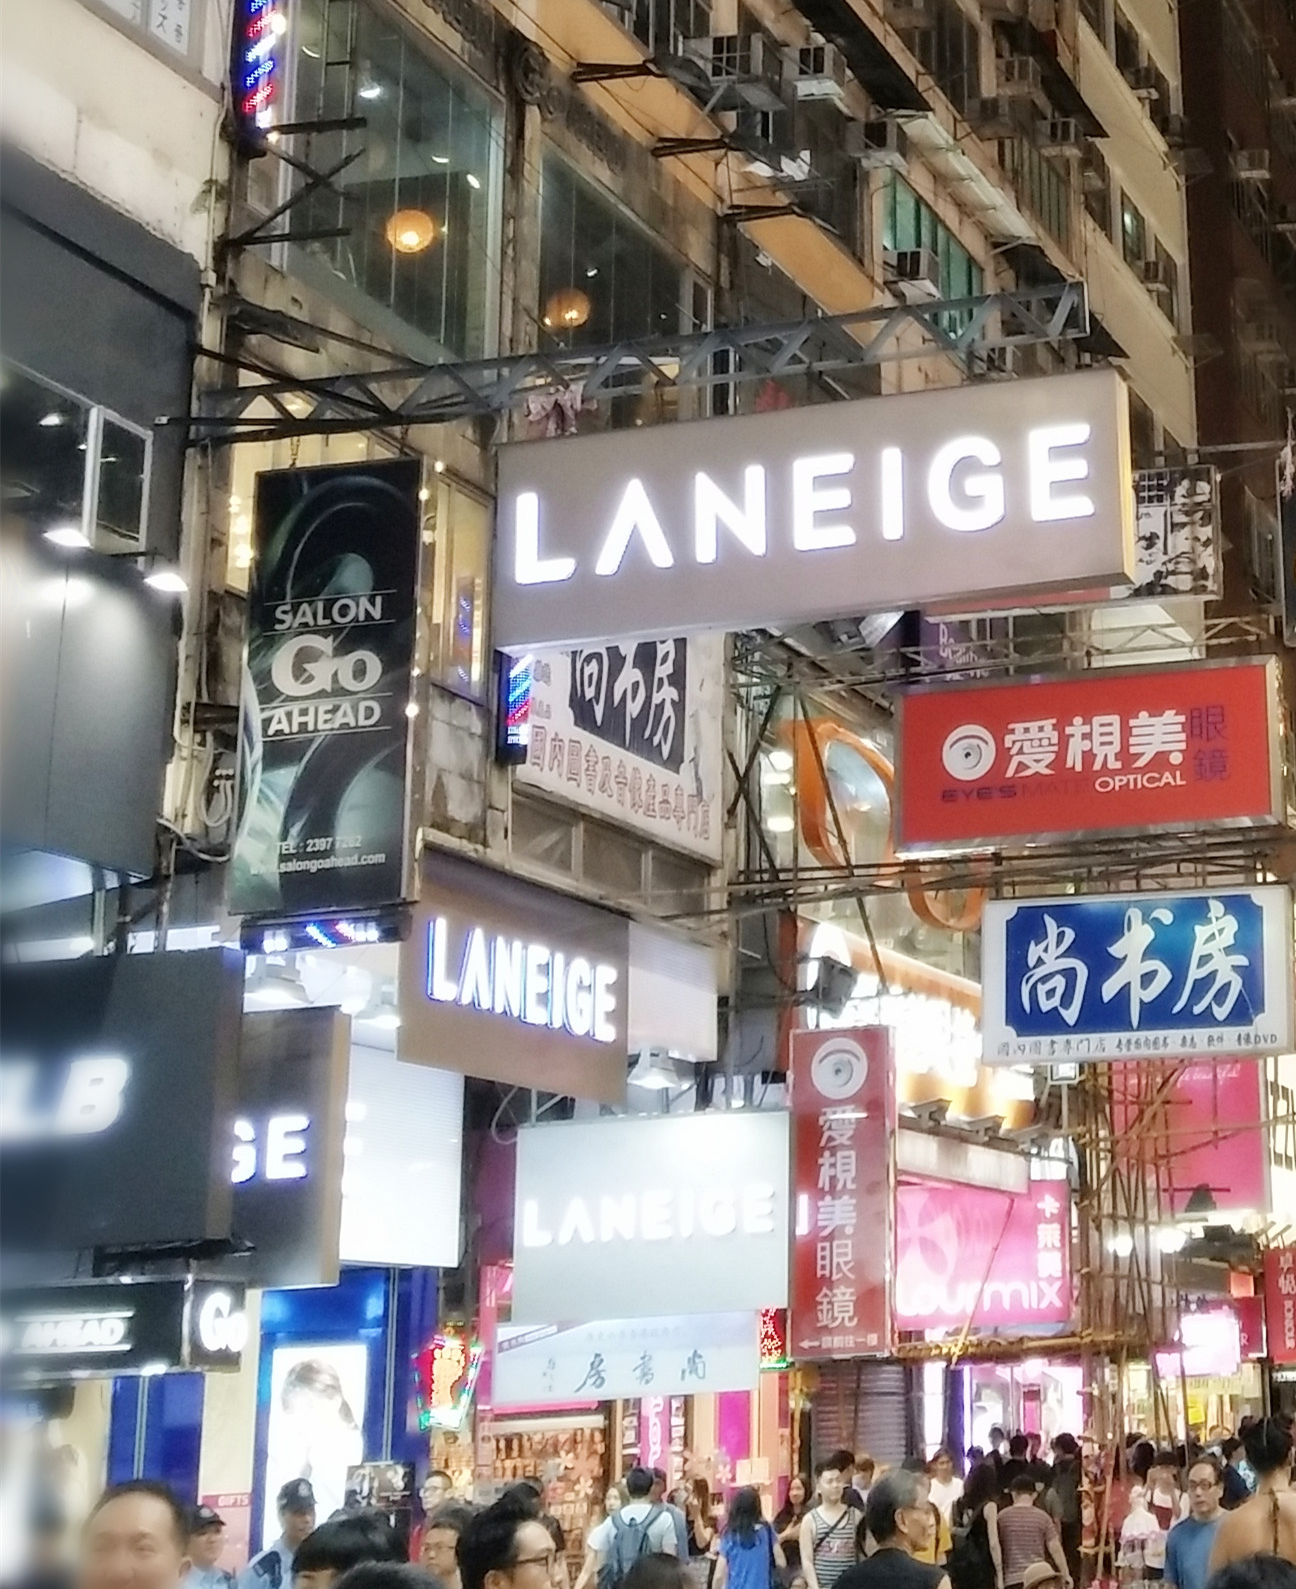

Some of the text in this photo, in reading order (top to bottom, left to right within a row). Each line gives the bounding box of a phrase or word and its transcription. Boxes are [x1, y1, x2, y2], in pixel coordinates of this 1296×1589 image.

[514, 422, 1097, 586] LANEIGE
[274, 595, 382, 631] SALON
[271, 633, 383, 697] Go
[267, 699, 382, 736] AHEAD
[1004, 709, 1188, 779] 愛視美
[1189, 704, 1231, 782] 眼鏡
[1094, 770, 1187, 794] OPTICAL
[306, 837, 334, 853] 2397
[427, 917, 618, 1043] LANEIGE
[1020, 898, 1250, 1030] 尚书房
[522, 1182, 776, 1248] LANEIGE
[815, 1105, 858, 1329] 愛視美眼鏡
[217, 1494, 249, 1507] GIFTS
